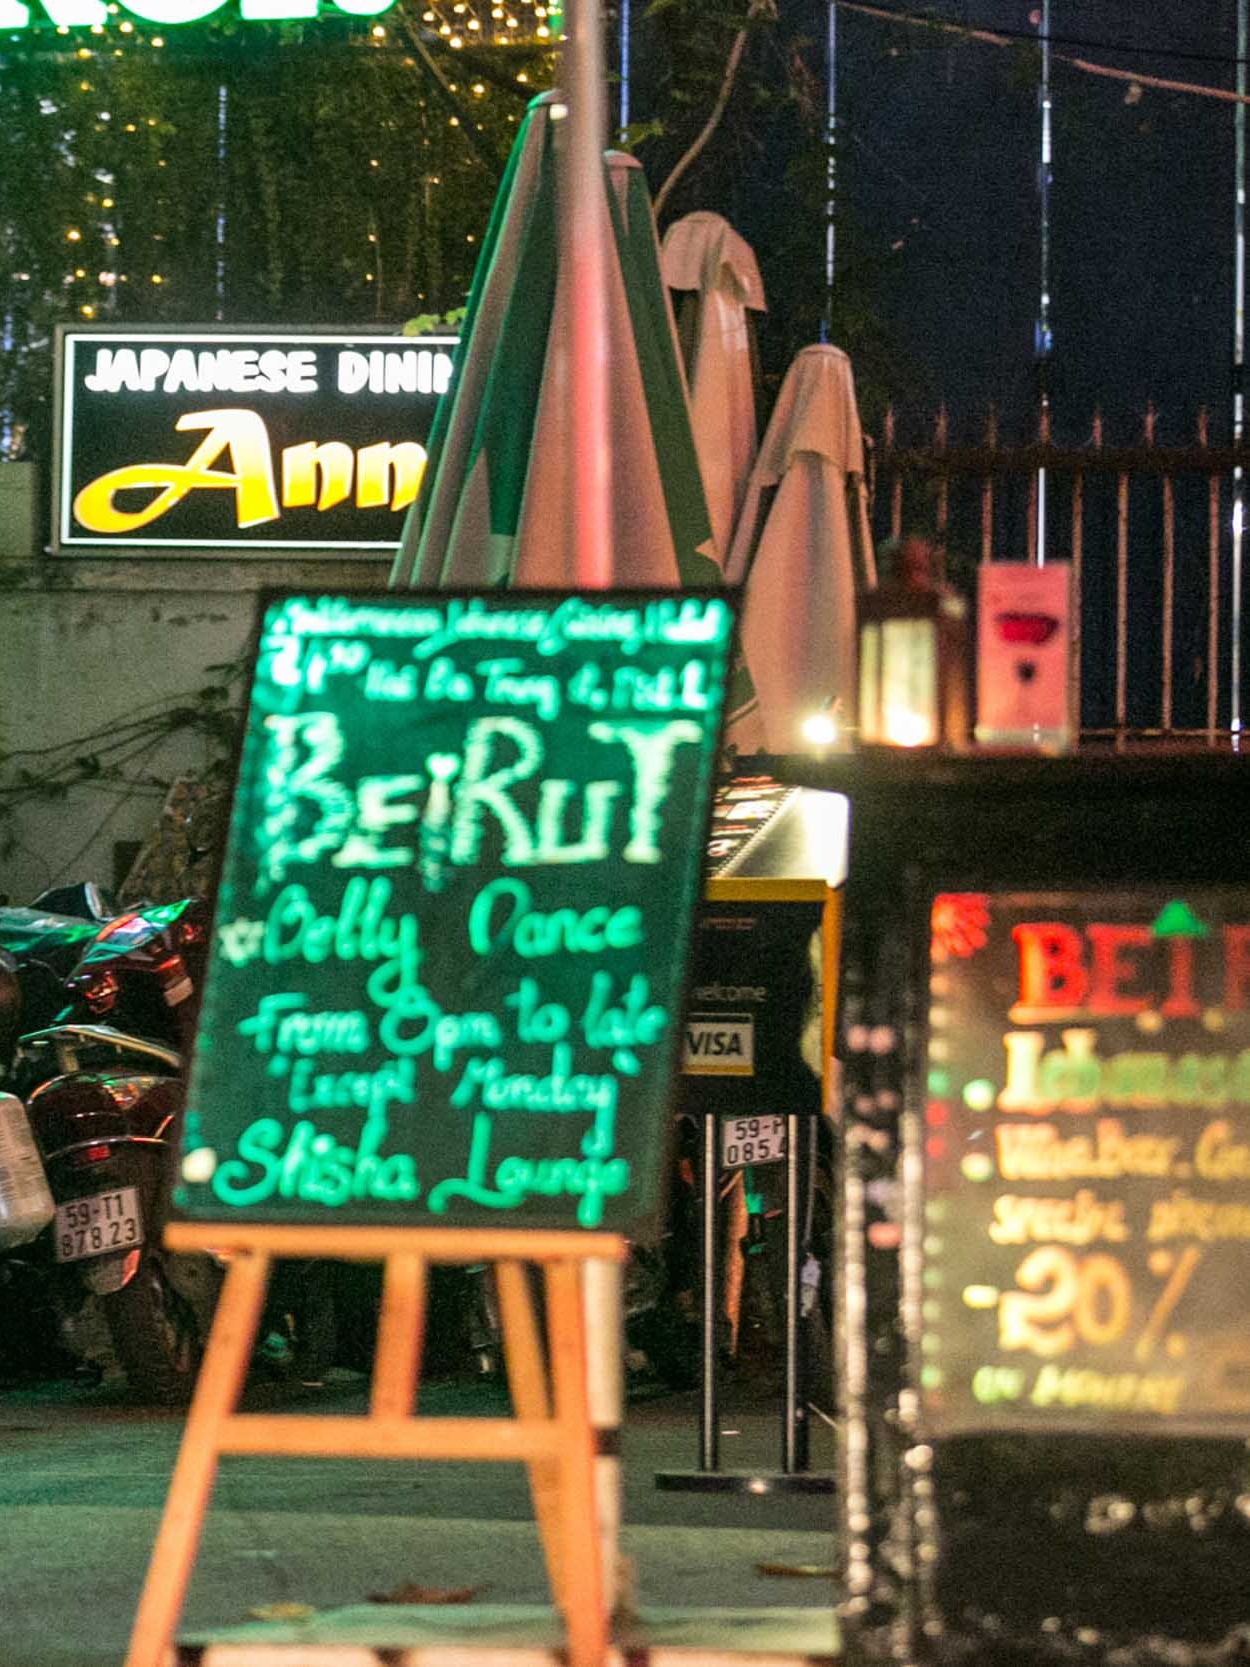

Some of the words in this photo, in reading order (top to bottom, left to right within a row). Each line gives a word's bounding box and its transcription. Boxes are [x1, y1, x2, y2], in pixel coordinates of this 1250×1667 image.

[85, 348, 319, 393] JAPANESE
[687, 1031, 743, 1056] VISA
[65, 1194, 124, 1229] 59-T1
